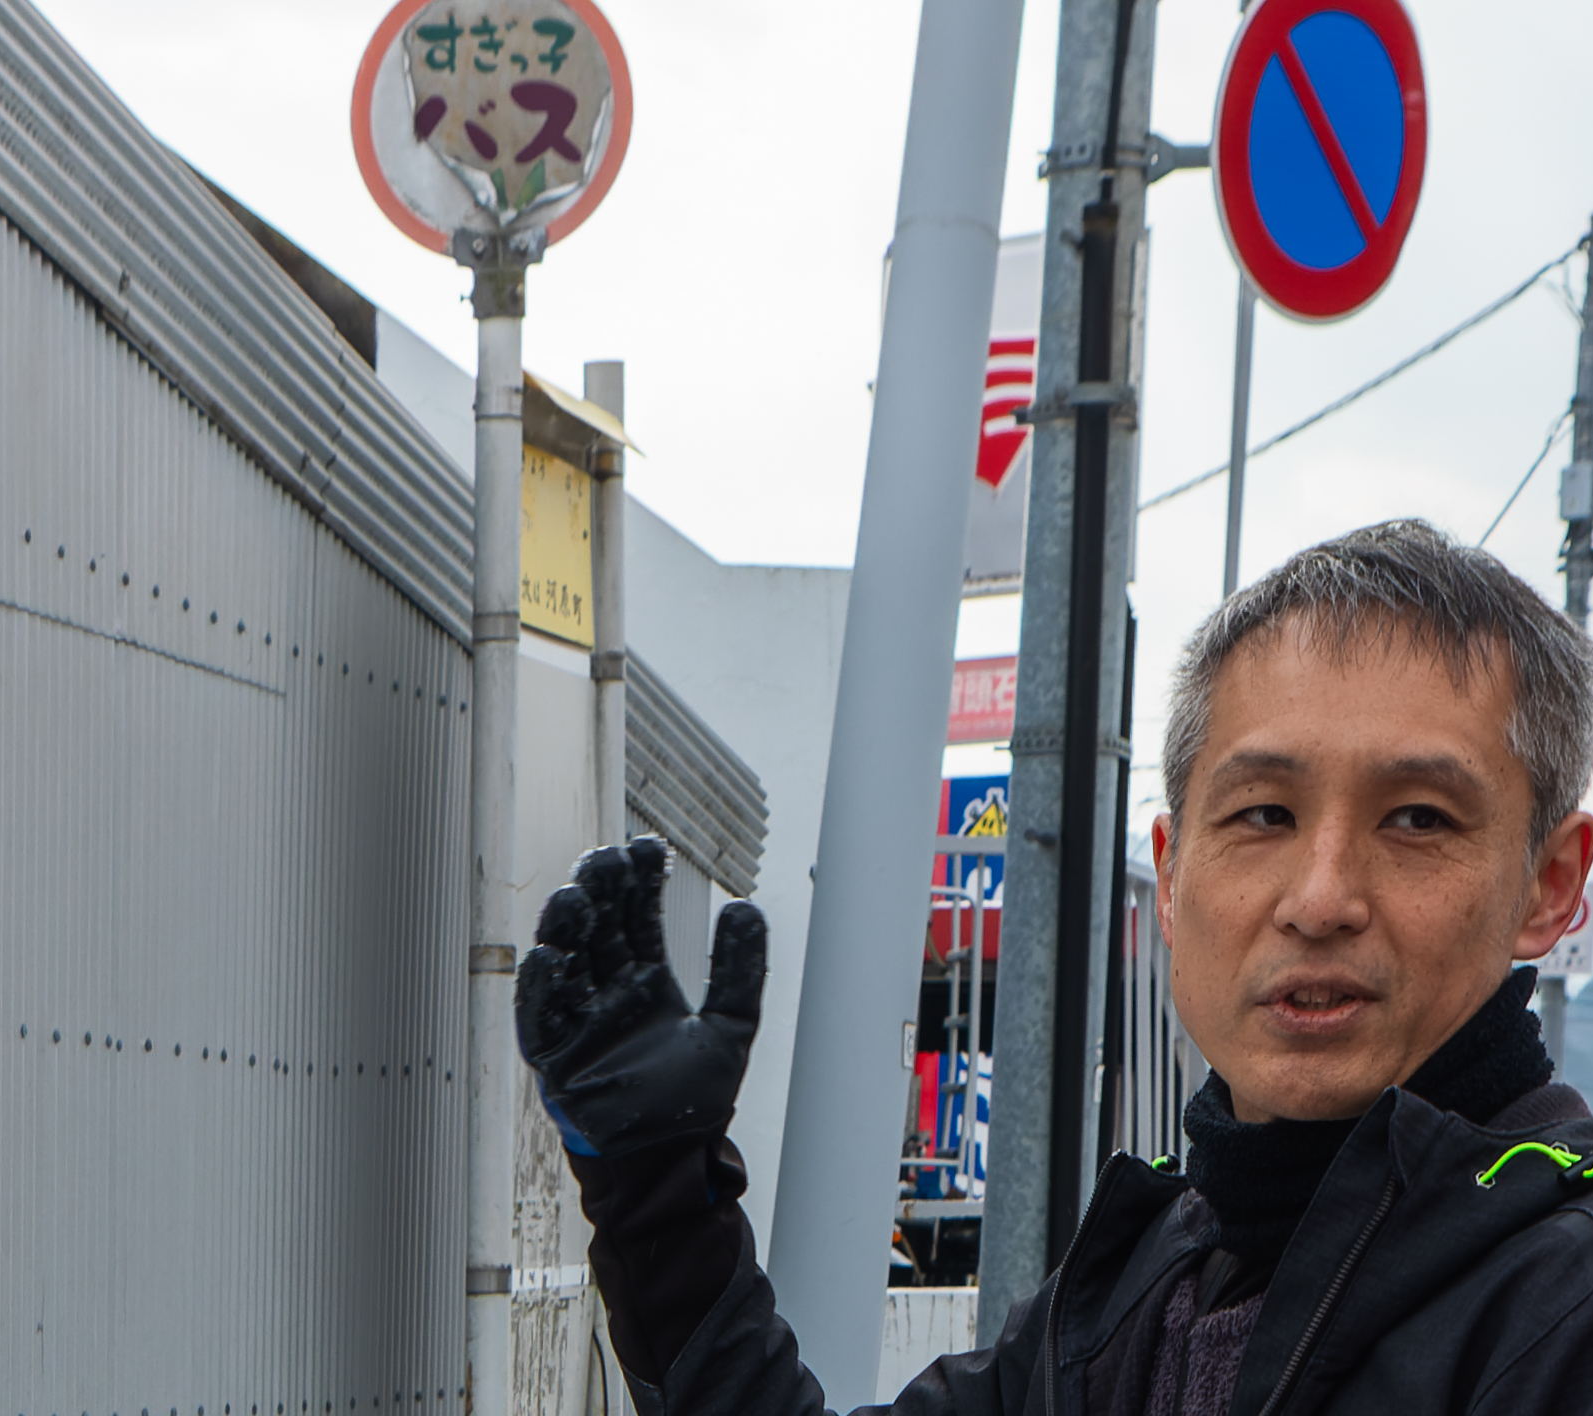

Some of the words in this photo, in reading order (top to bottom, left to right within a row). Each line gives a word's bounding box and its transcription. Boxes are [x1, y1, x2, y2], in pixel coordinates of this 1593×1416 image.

[416, 9, 576, 74] すぎっ子
[414, 79, 583, 164] バス
